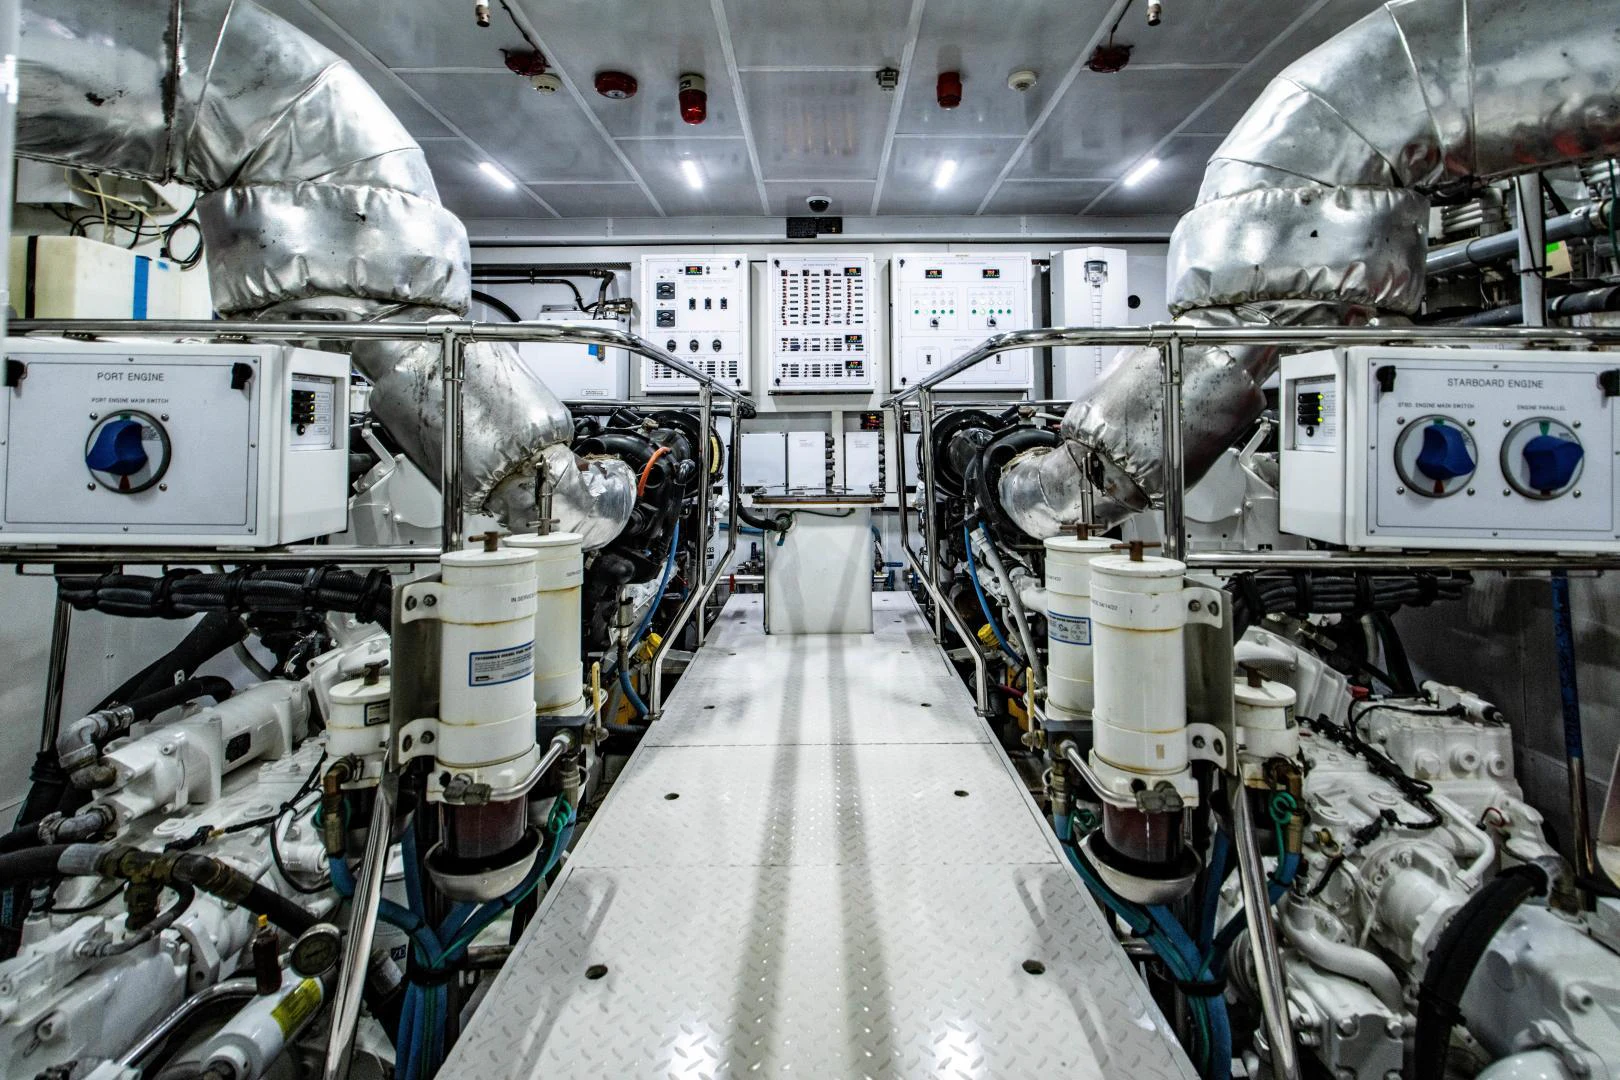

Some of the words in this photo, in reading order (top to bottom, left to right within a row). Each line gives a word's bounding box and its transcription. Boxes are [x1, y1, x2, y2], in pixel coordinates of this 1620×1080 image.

[97, 372, 124, 381] PORT
[128, 372, 165, 381] ENGINE
[1447, 377, 1505, 388] STARBOARD
[1508, 379, 1544, 389] ENGINE
